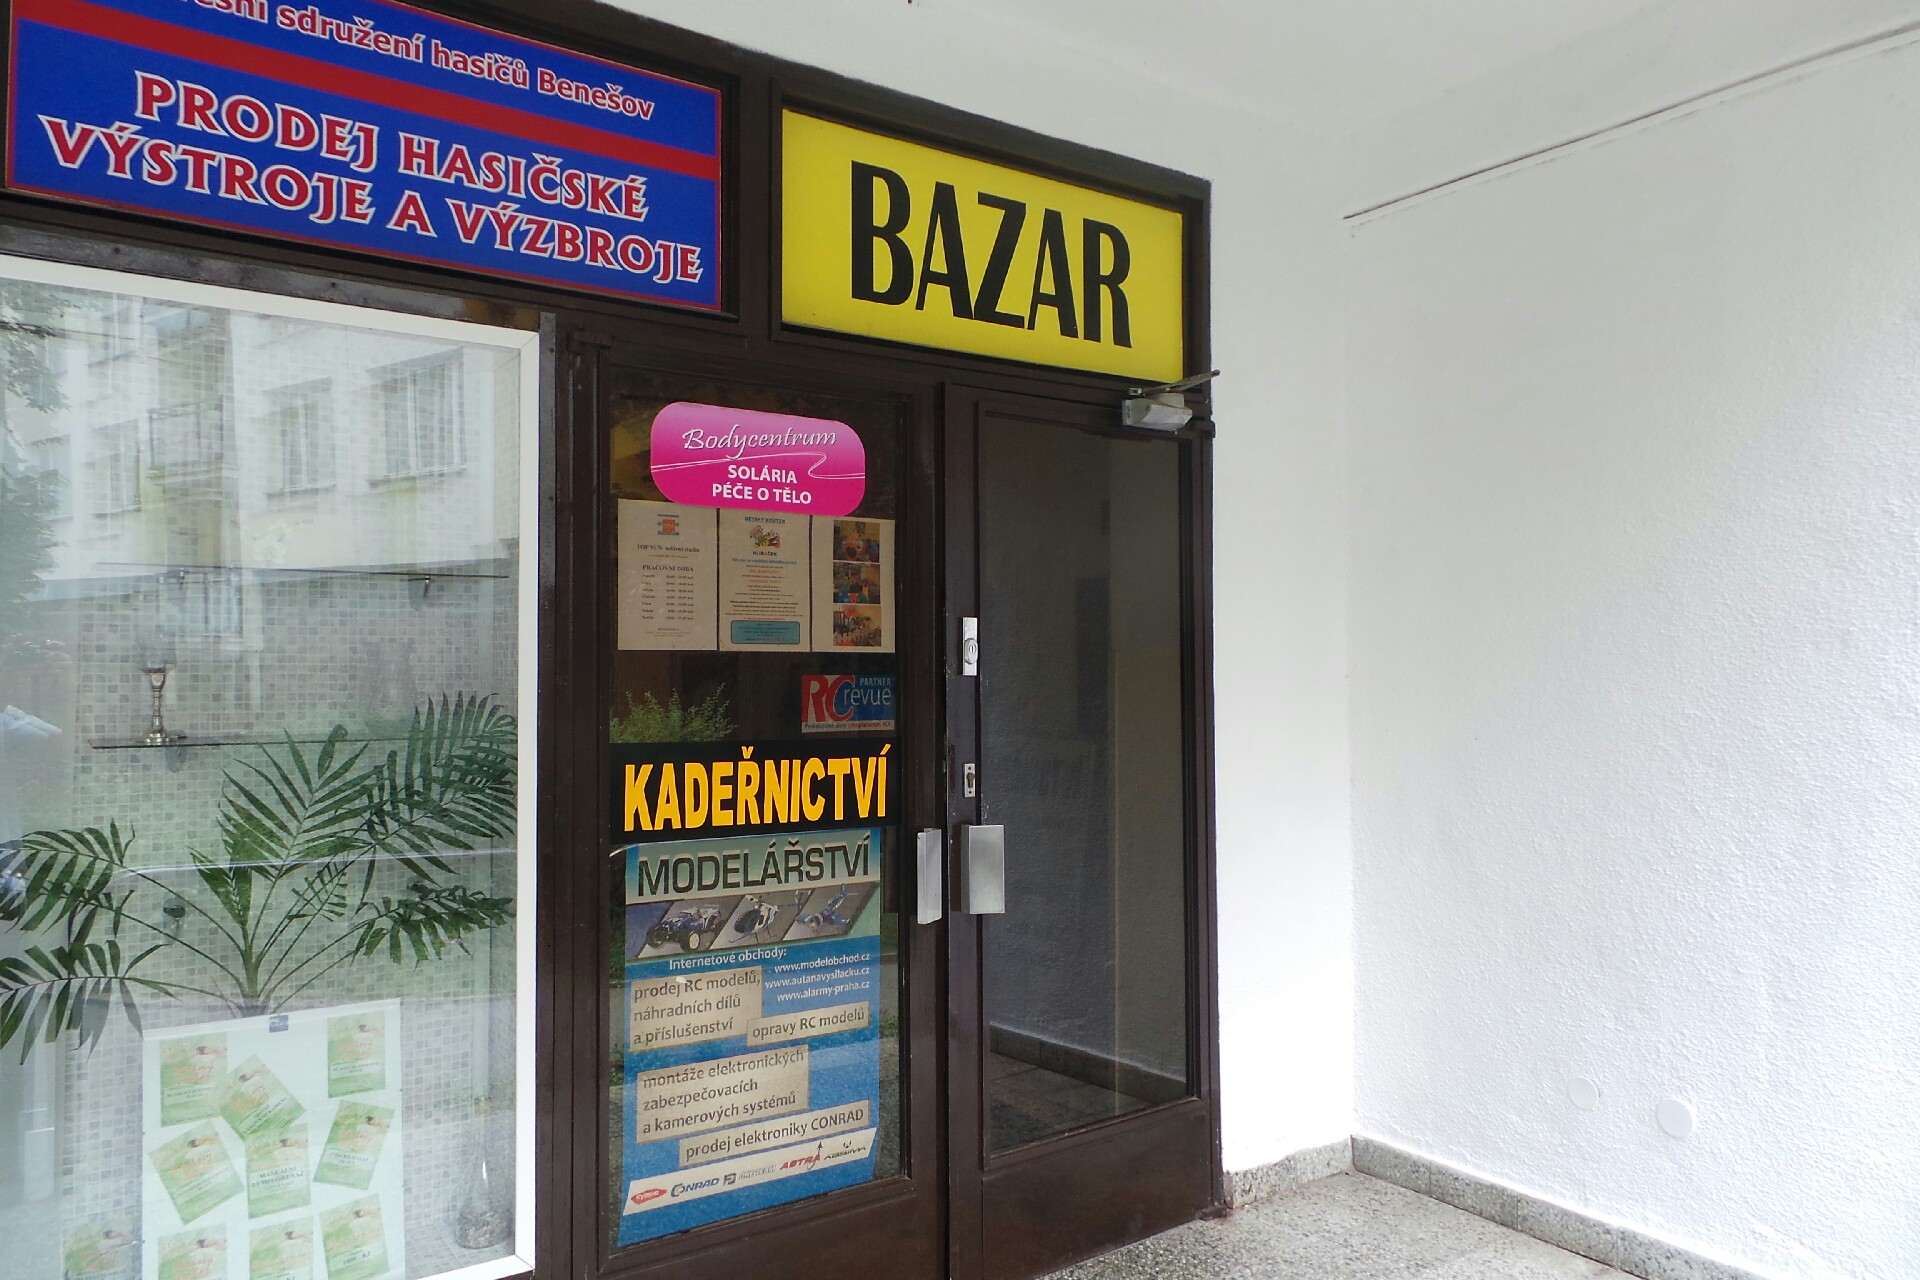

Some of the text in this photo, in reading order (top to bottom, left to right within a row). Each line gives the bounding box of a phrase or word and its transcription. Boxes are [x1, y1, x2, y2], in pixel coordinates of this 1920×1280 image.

[277, 5, 426, 63] sdružení
[432, 39, 530, 91] hasičů
[537, 67, 655, 121] Benešov
[134, 70, 648, 223] PRODEJ HASIČSKÉ
[37, 113, 705, 284] VÝSTROJE A VÝZBROJE
[850, 159, 1133, 349] BAZAR
[682, 423, 837, 461] Bodycentrum
[727, 463, 798, 485] SOLÁRIA
[712, 482, 812, 505] PÉČE O TĚLO
[801, 675, 892, 722] RC revue
[859, 677, 892, 687] PARTNER
[624, 743, 892, 832] KADEŘNICTVÍ
[637, 831, 871, 897] MODELÁŘSTVÍ
[668, 947, 788, 971] Internetové obchody:
[774, 952, 871, 973] www.modelobchod.cz
[633, 980, 681, 1003] prodej
[684, 978, 703, 993] RC
[765, 967, 871, 989] www.autanavysilacku.cz
[776, 980, 871, 1002] www.alarmy-praha.cz
[633, 994, 741, 1022] náhradních dílů
[752, 1006, 865, 1040] opravy RC modelů
[633, 1016, 734, 1046] a příslušenství
[643, 1048, 804, 1089] montáže elektronických
[643, 1079, 758, 1111] zabezpečovacích
[643, 1090, 796, 1135] a kamerových systémů
[685, 1107, 864, 1160] prodej elektroniky CONRAD
